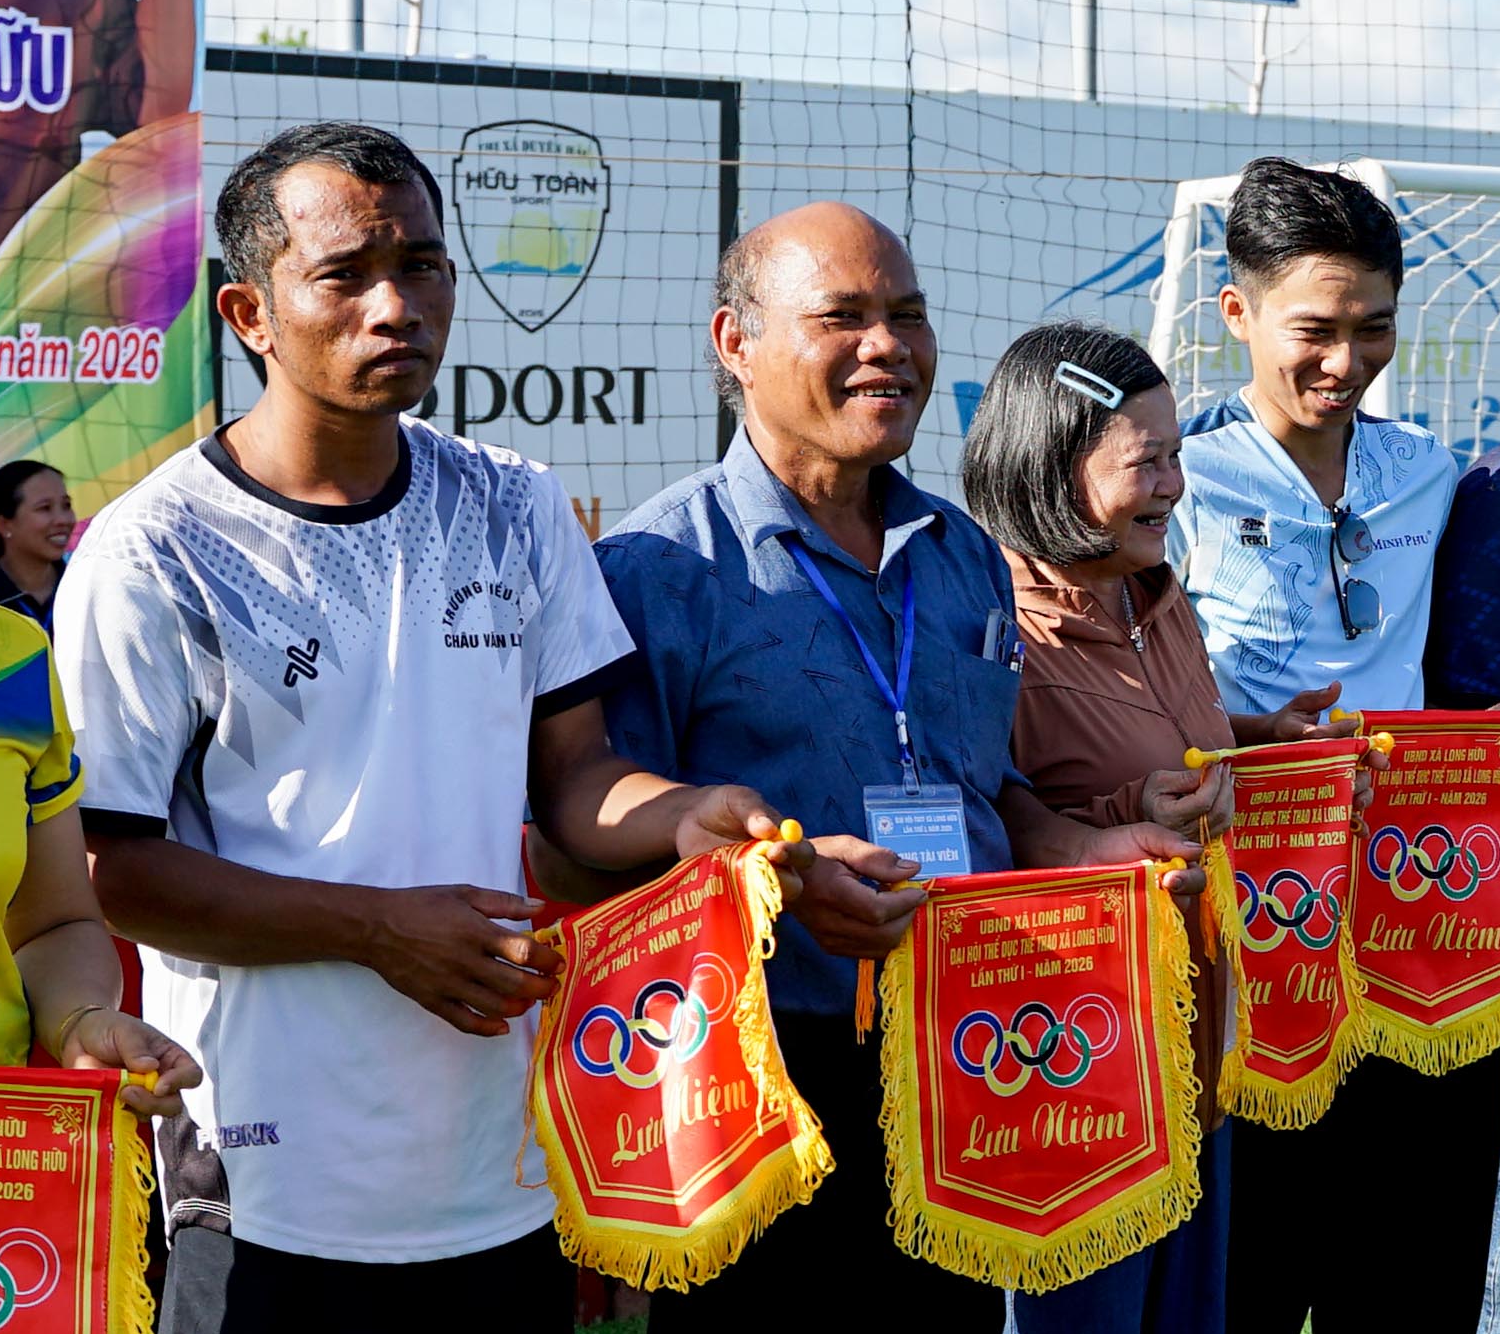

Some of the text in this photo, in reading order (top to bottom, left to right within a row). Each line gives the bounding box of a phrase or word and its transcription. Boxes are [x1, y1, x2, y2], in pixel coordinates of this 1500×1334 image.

[466, 167, 597, 194] HỮU TOÀN
[80, 331, 161, 380] 2026
[420, 364, 657, 436] PORT
[445, 631, 479, 648] CHÂU
[980, 904, 1087, 935] UBND XÃ LONG HỮU
[960, 1101, 1130, 1163] Lưu Niệm
[6, 1149, 38, 1170] LONG
[42, 1147, 67, 1172] HỮU
